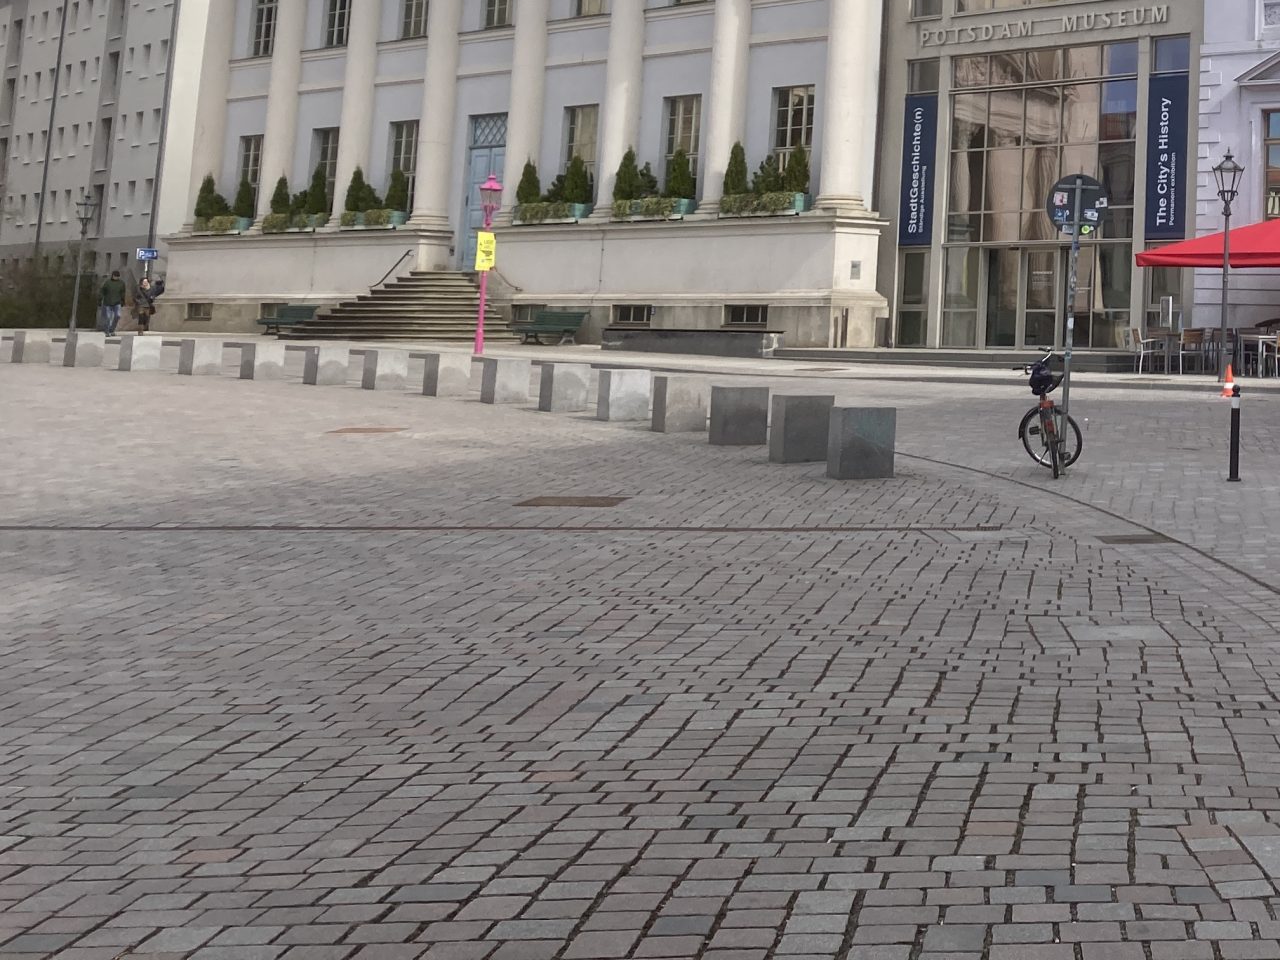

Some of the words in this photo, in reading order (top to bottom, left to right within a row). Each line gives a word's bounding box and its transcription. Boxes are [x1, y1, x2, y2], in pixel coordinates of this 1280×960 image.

[920, 20, 1033, 48] POTSDAM
[1061, 5, 1169, 33] MUSEUM
[1158, 97, 1172, 149] History
[908, 107, 924, 233] StadtGeschichte(n)
[1156, 198, 1167, 226] The
